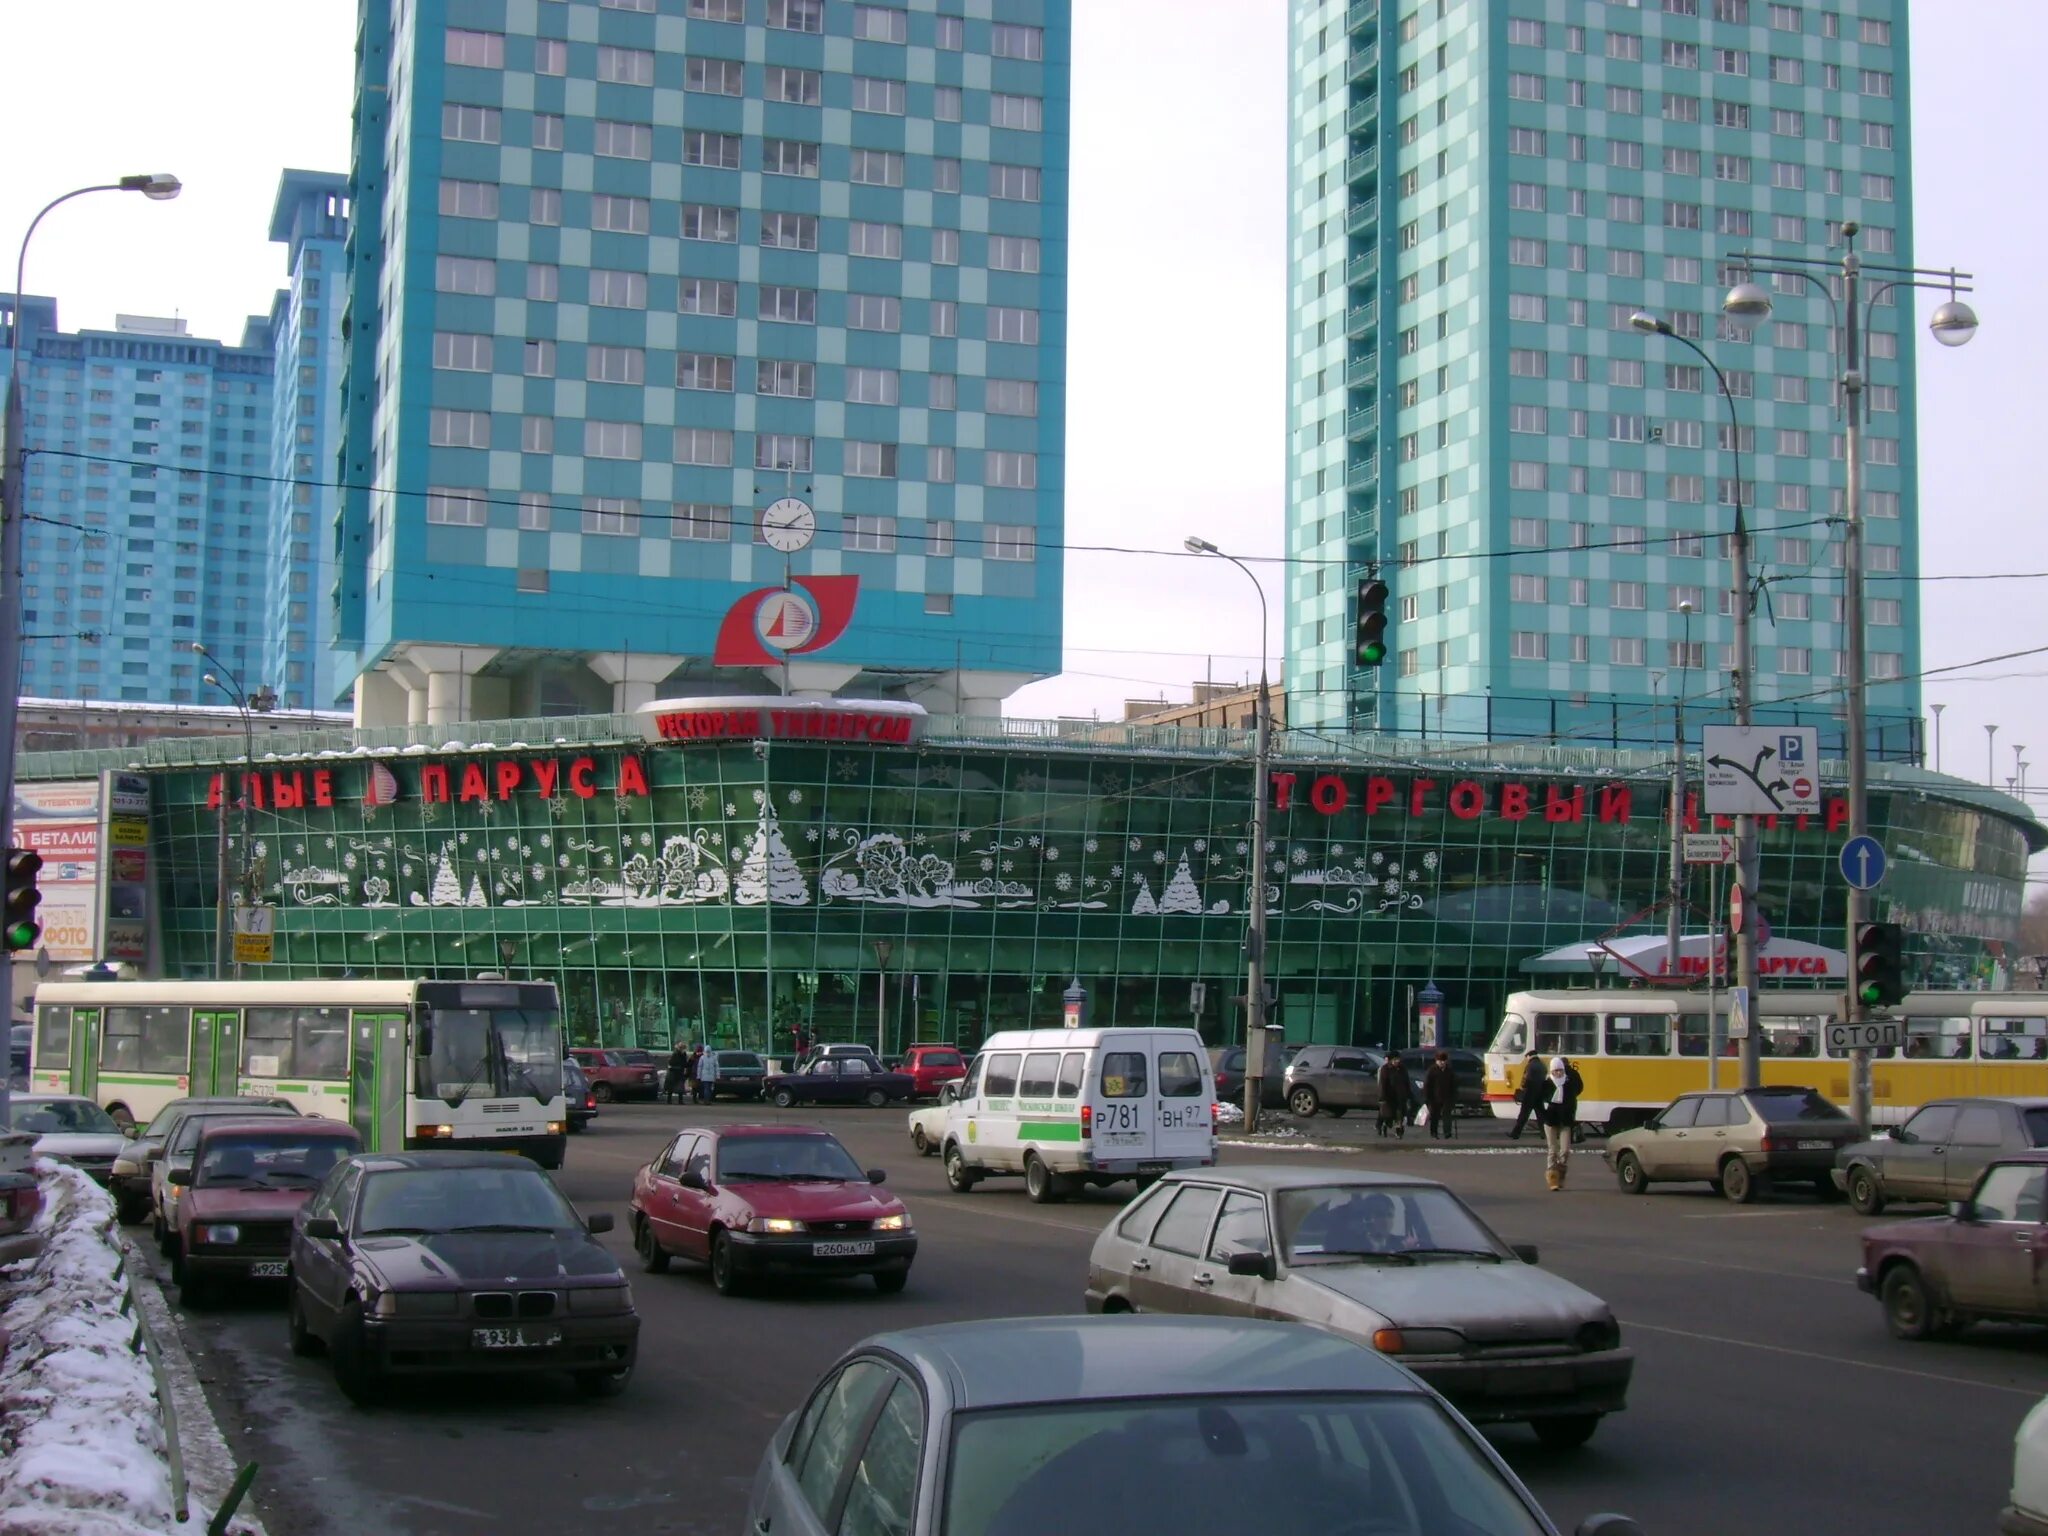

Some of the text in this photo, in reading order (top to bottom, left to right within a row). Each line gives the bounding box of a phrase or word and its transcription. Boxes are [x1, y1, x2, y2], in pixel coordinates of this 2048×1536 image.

[656, 711, 760, 738] РЕСТОРАН
[421, 755, 649, 803] ПАРУСА
[1271, 771, 1632, 826] ТОРГОВЫЙ
[44, 926, 88, 945] ФОТО
[1832, 1025, 1898, 1046] СТОП
[1185, 1105, 1201, 1119] 97
